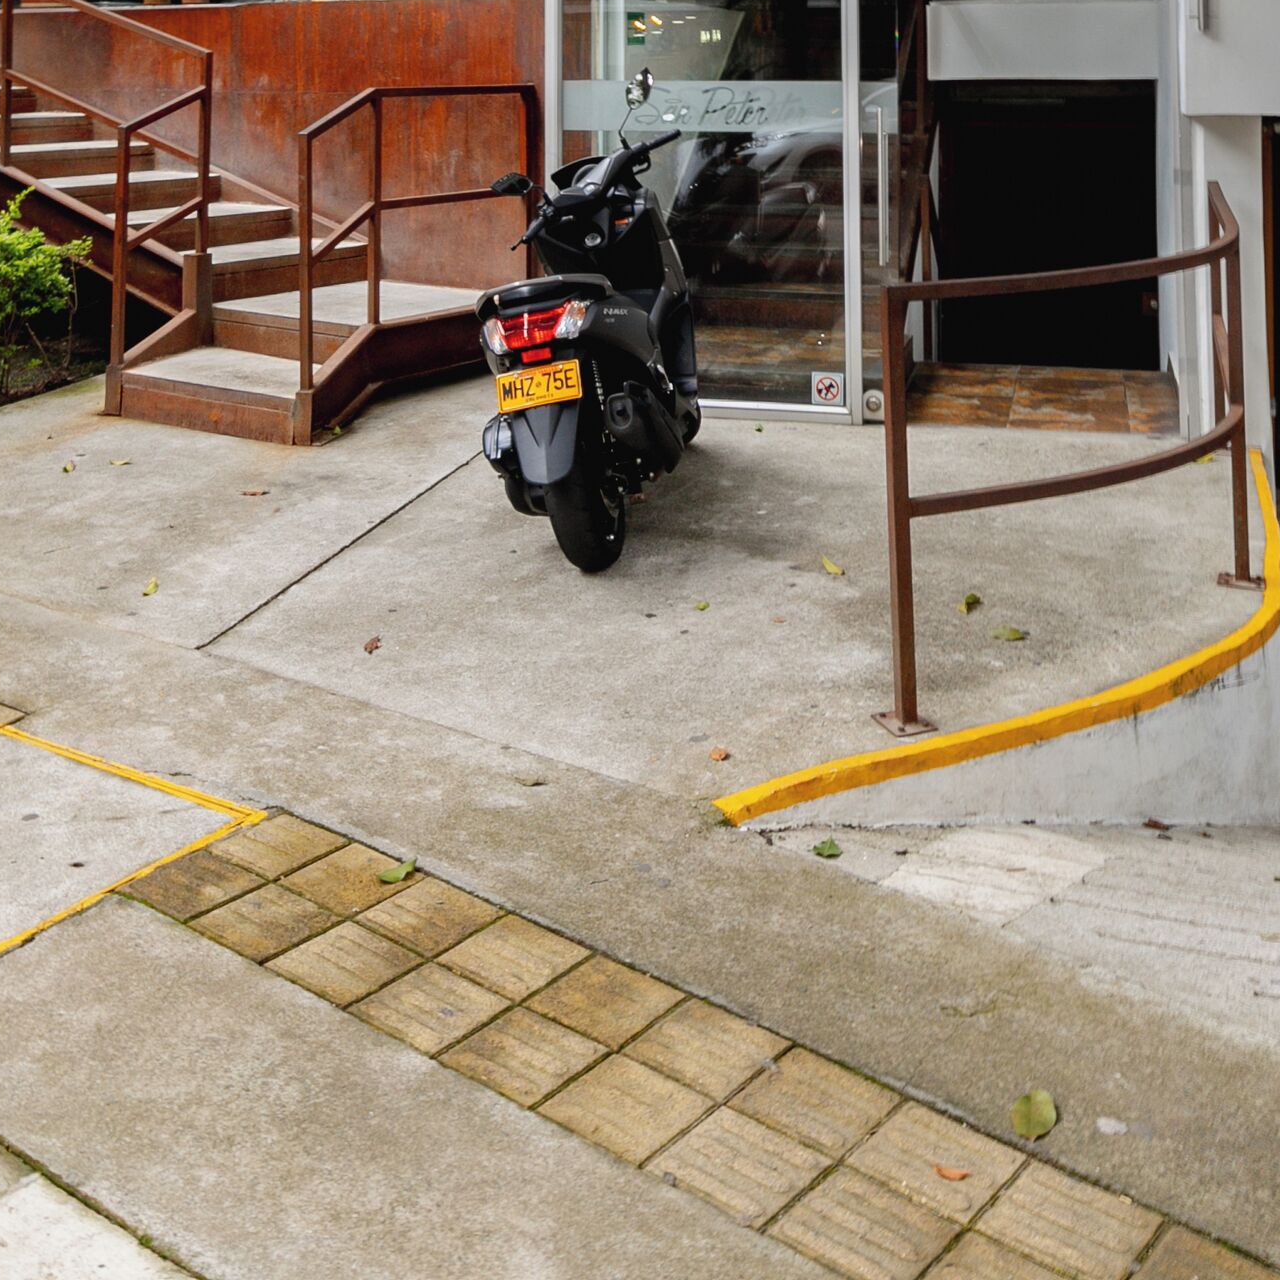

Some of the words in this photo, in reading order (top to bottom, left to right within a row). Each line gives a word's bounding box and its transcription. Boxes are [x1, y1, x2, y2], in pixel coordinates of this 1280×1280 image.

[698, 86, 769, 126] Peter
[502, 376, 535, 402] MHZ
[542, 368, 576, 392] 75E
